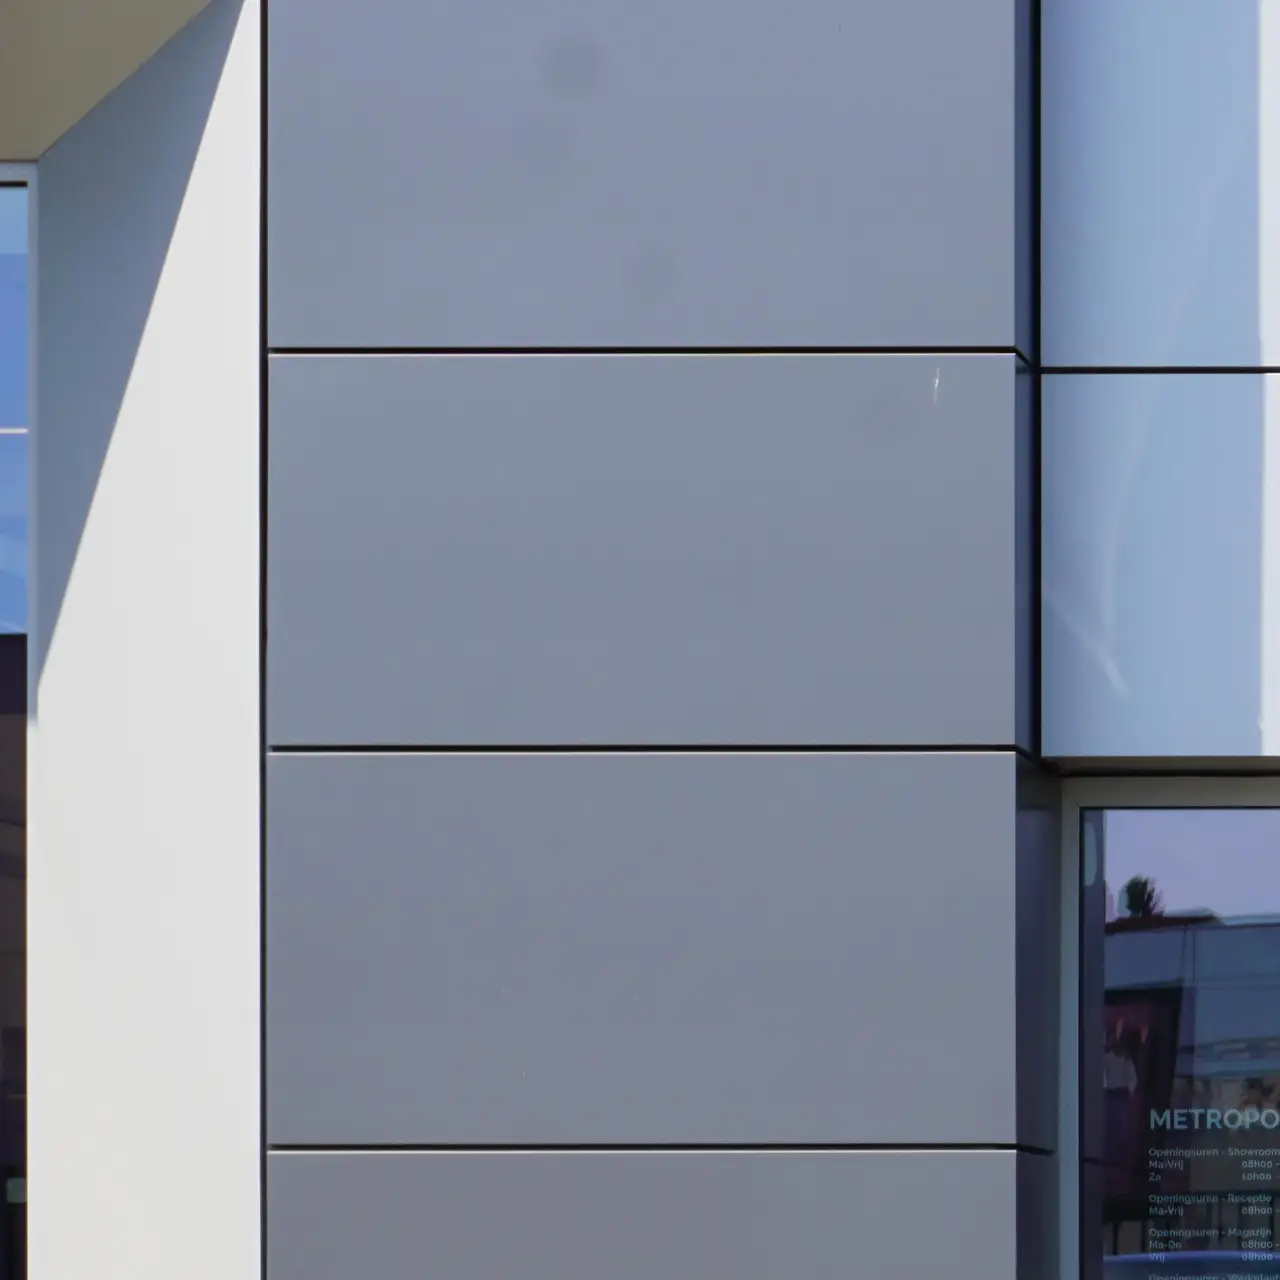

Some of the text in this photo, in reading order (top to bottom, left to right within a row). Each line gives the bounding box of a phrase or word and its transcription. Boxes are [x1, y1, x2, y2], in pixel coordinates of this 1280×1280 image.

[1148, 1147, 1219, 1158] Openingsuren
[1227, 1147, 1280, 1156] Showroom
[1149, 1159, 1184, 1170] Ma-Vrij
[1241, 1159, 1273, 1168] 08h00
[1149, 1172, 1161, 1181] Za
[1241, 1172, 1273, 1181] 10h00
[1148, 1194, 1219, 1205] Openingsuren
[1227, 1193, 1272, 1205] Receptie
[1149, 1205, 1184, 1217] Ma-Vrij
[1241, 1206, 1273, 1215] 08h00
[1148, 1228, 1219, 1239] Openingsuren
[1227, 1228, 1272, 1239] Magazijn
[1149, 1240, 1182, 1249] Ma-Do
[1241, 1240, 1273, 1249] 08h00
[1149, 1252, 1165, 1263] Vrij
[1241, 1252, 1273, 1261] 08h00
